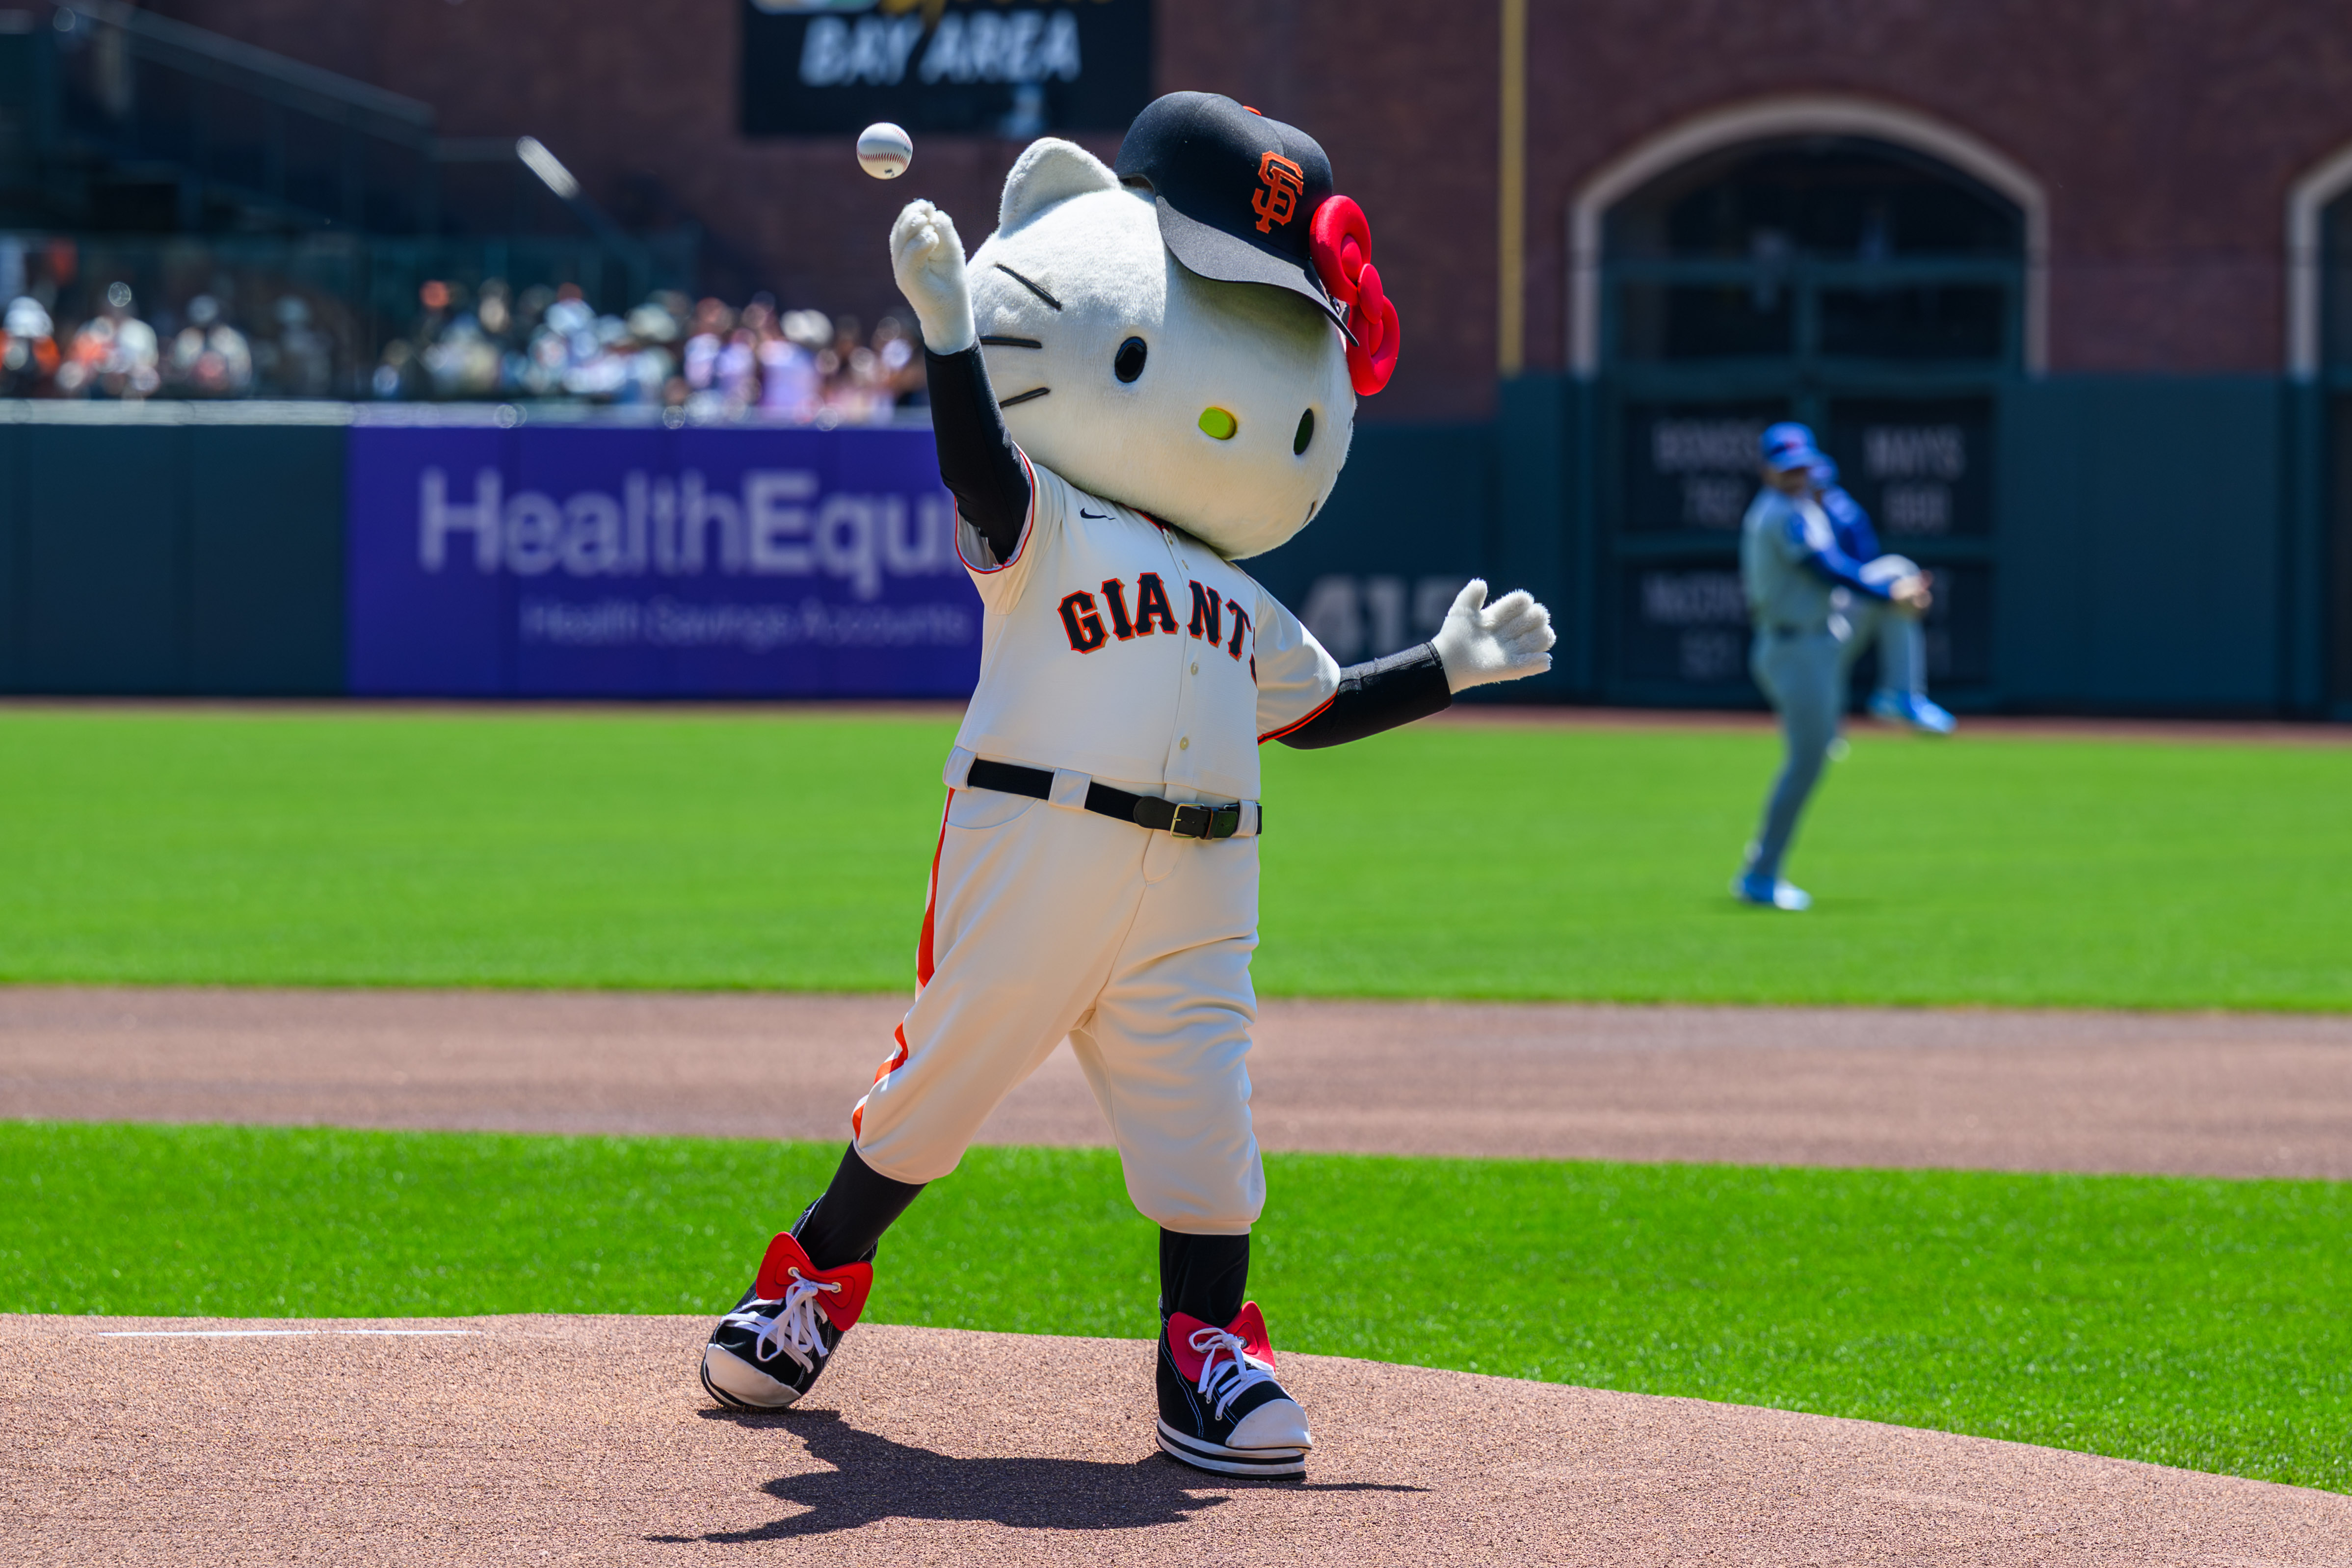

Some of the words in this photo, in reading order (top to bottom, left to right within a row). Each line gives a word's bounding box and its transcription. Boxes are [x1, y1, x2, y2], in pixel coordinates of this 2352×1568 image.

[804, 18, 917, 82] BAY
[923, 14, 1076, 80] AREA
[525, 600, 646, 639] Health
[649, 599, 793, 646] Savings
[797, 600, 970, 639] Accounts
[1057, 572, 1257, 687] GIANT
